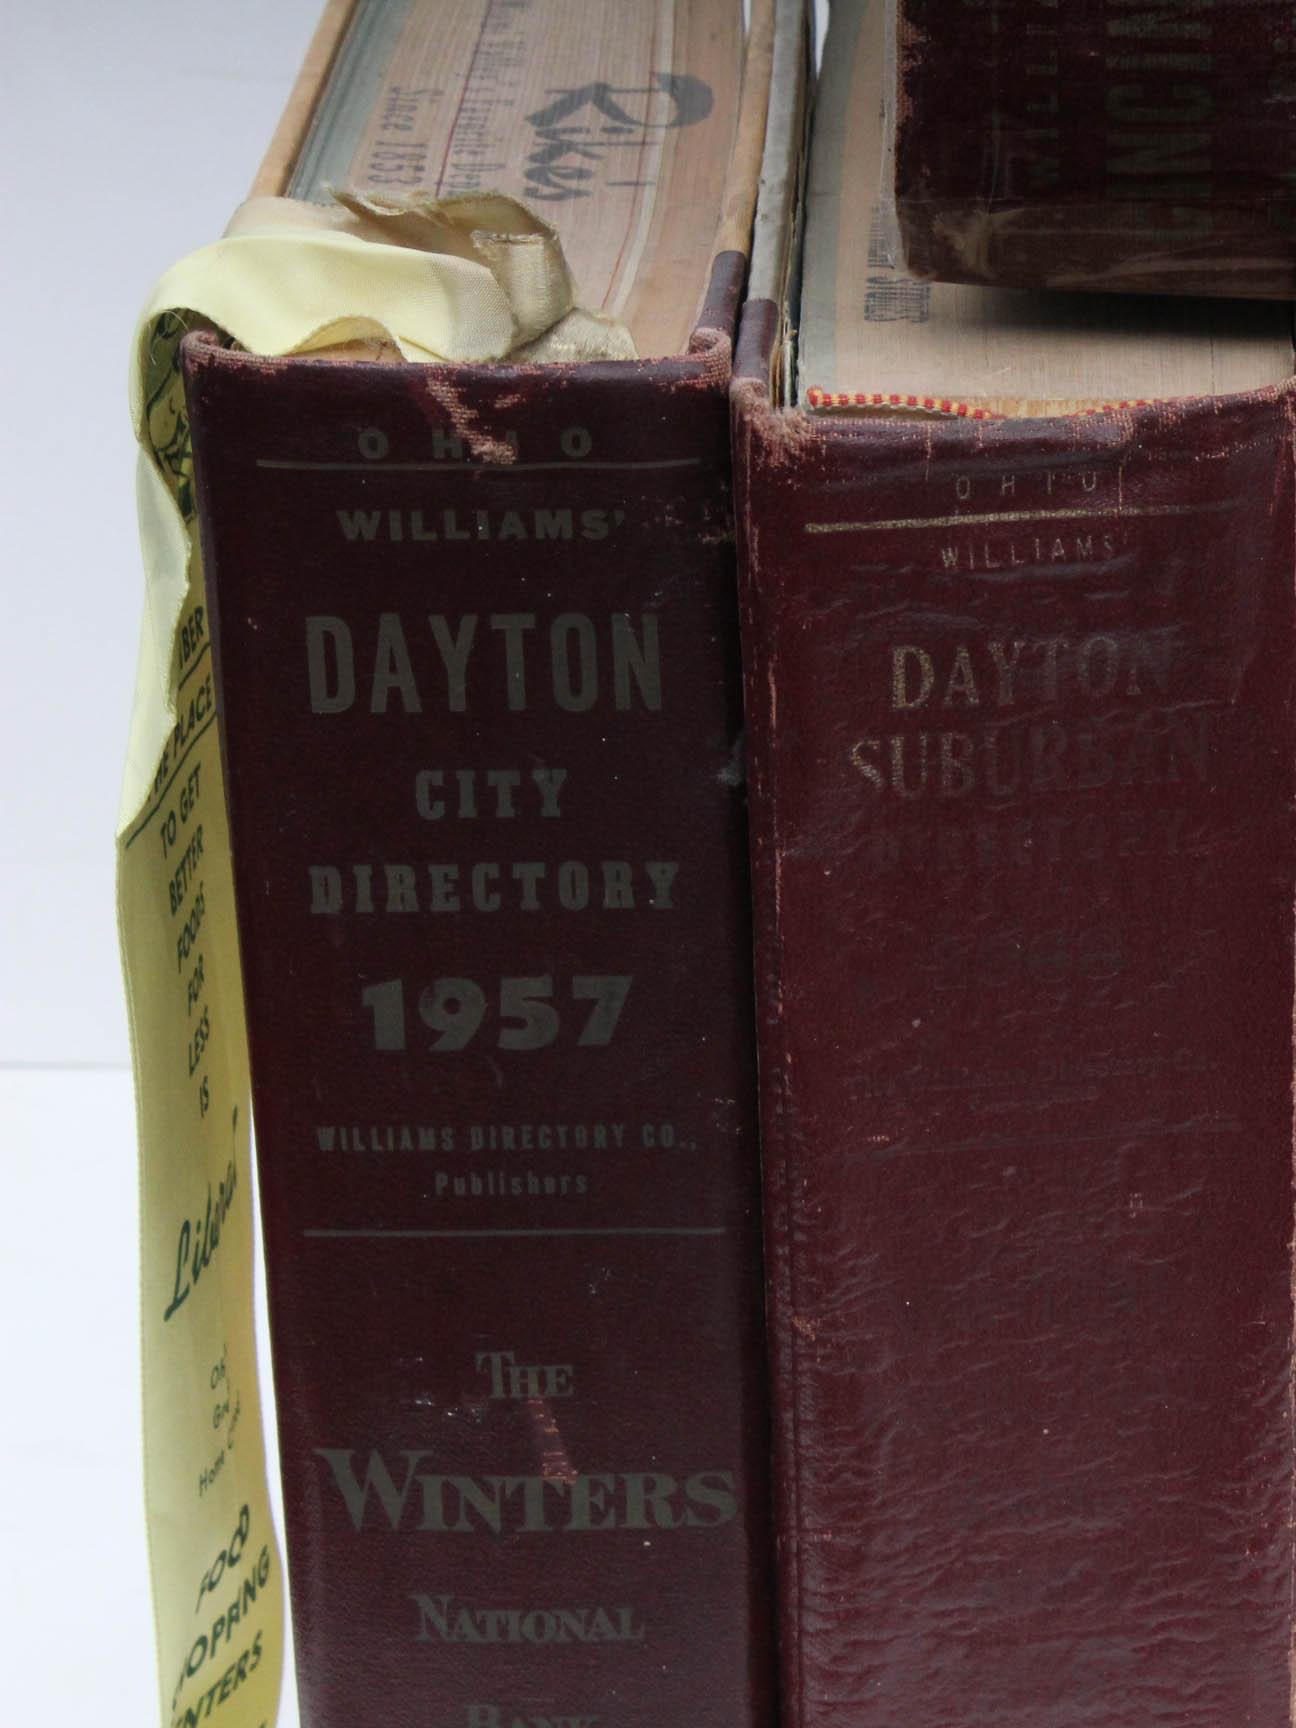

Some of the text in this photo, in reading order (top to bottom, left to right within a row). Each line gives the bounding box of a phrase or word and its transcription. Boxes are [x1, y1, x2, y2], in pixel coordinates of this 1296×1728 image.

[366, 139, 430, 187] 1853
[336, 508, 627, 541] WILLIAMS'
[178, 605, 204, 670] BER
[305, 612, 664, 715] DAYTON
[160, 762, 202, 860] TO GET
[415, 769, 569, 821] CITY
[169, 823, 204, 917] BETTER
[308, 861, 681, 914] DIRECTORY
[361, 973, 634, 1053] 1957
[315, 1126, 455, 1153] WILLIAMS
[470, 1124, 626, 1152] DIRECTORY
[434, 1172, 588, 1198] Publishers
[475, 1350, 575, 1400] THE
[313, 1447, 740, 1534] WINTERS
[194, 1503, 251, 1616] FOOD
[410, 1593, 646, 1643] NATIONAL
